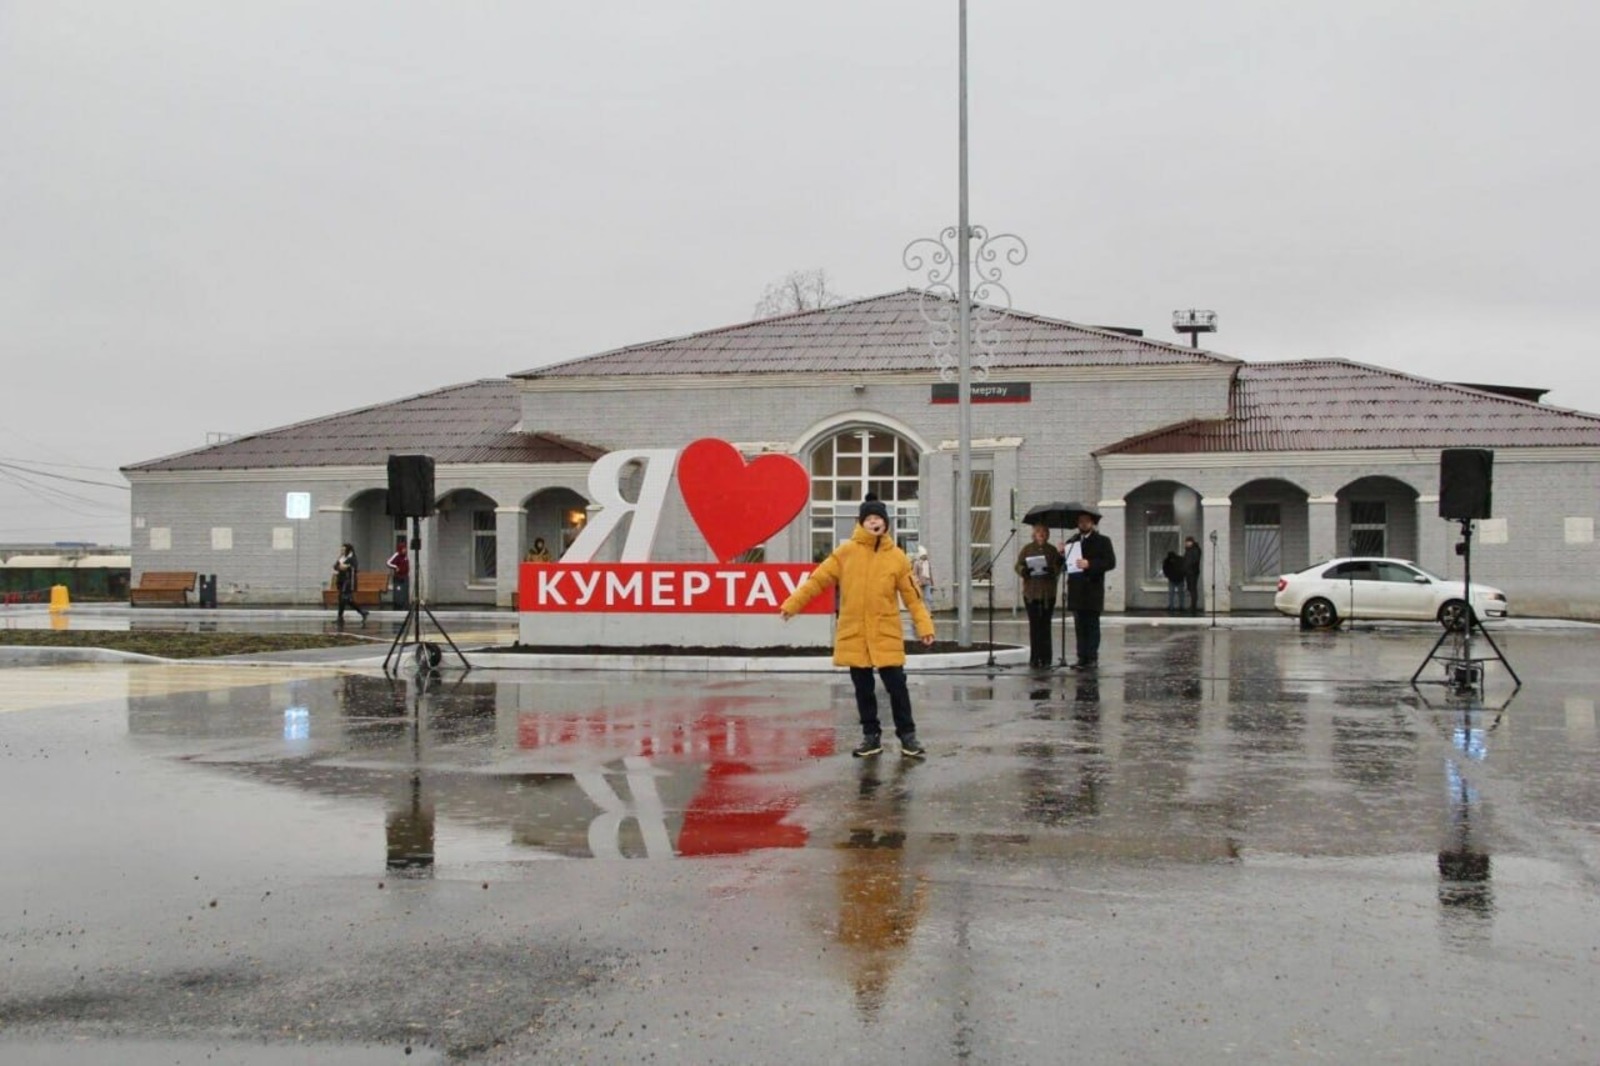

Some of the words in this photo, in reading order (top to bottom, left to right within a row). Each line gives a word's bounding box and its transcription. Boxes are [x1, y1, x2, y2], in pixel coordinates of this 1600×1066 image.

[960, 386, 1008, 397] мертау
[559, 449, 677, 563] Я
[538, 570, 811, 606] КУМЕРТАУ
